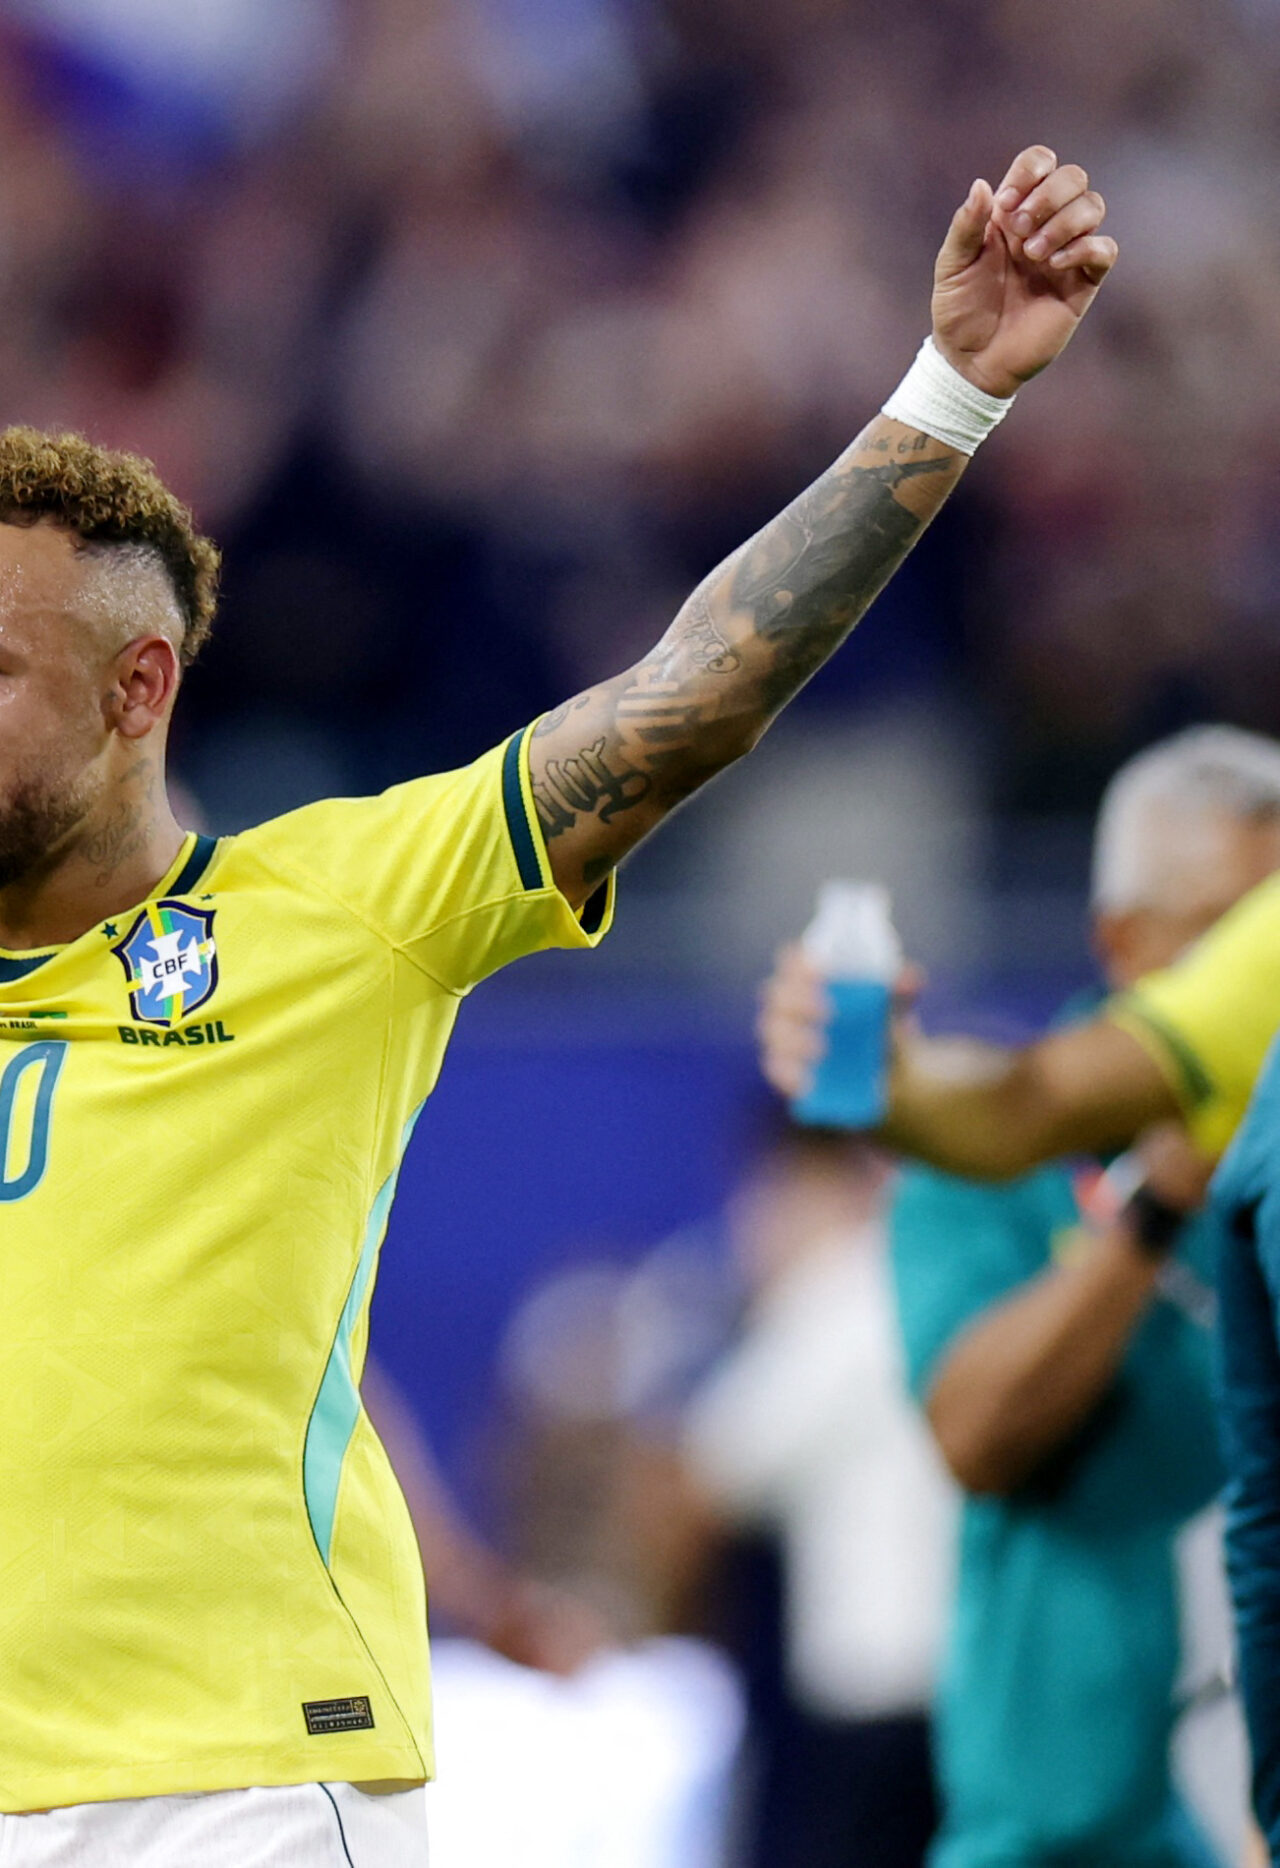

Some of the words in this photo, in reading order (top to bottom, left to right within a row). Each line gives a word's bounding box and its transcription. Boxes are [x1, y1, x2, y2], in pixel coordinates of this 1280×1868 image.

[152, 953, 188, 979] CBF
[9, 1020, 38, 1030] BRASIL
[117, 1020, 235, 1047] BRASIL
